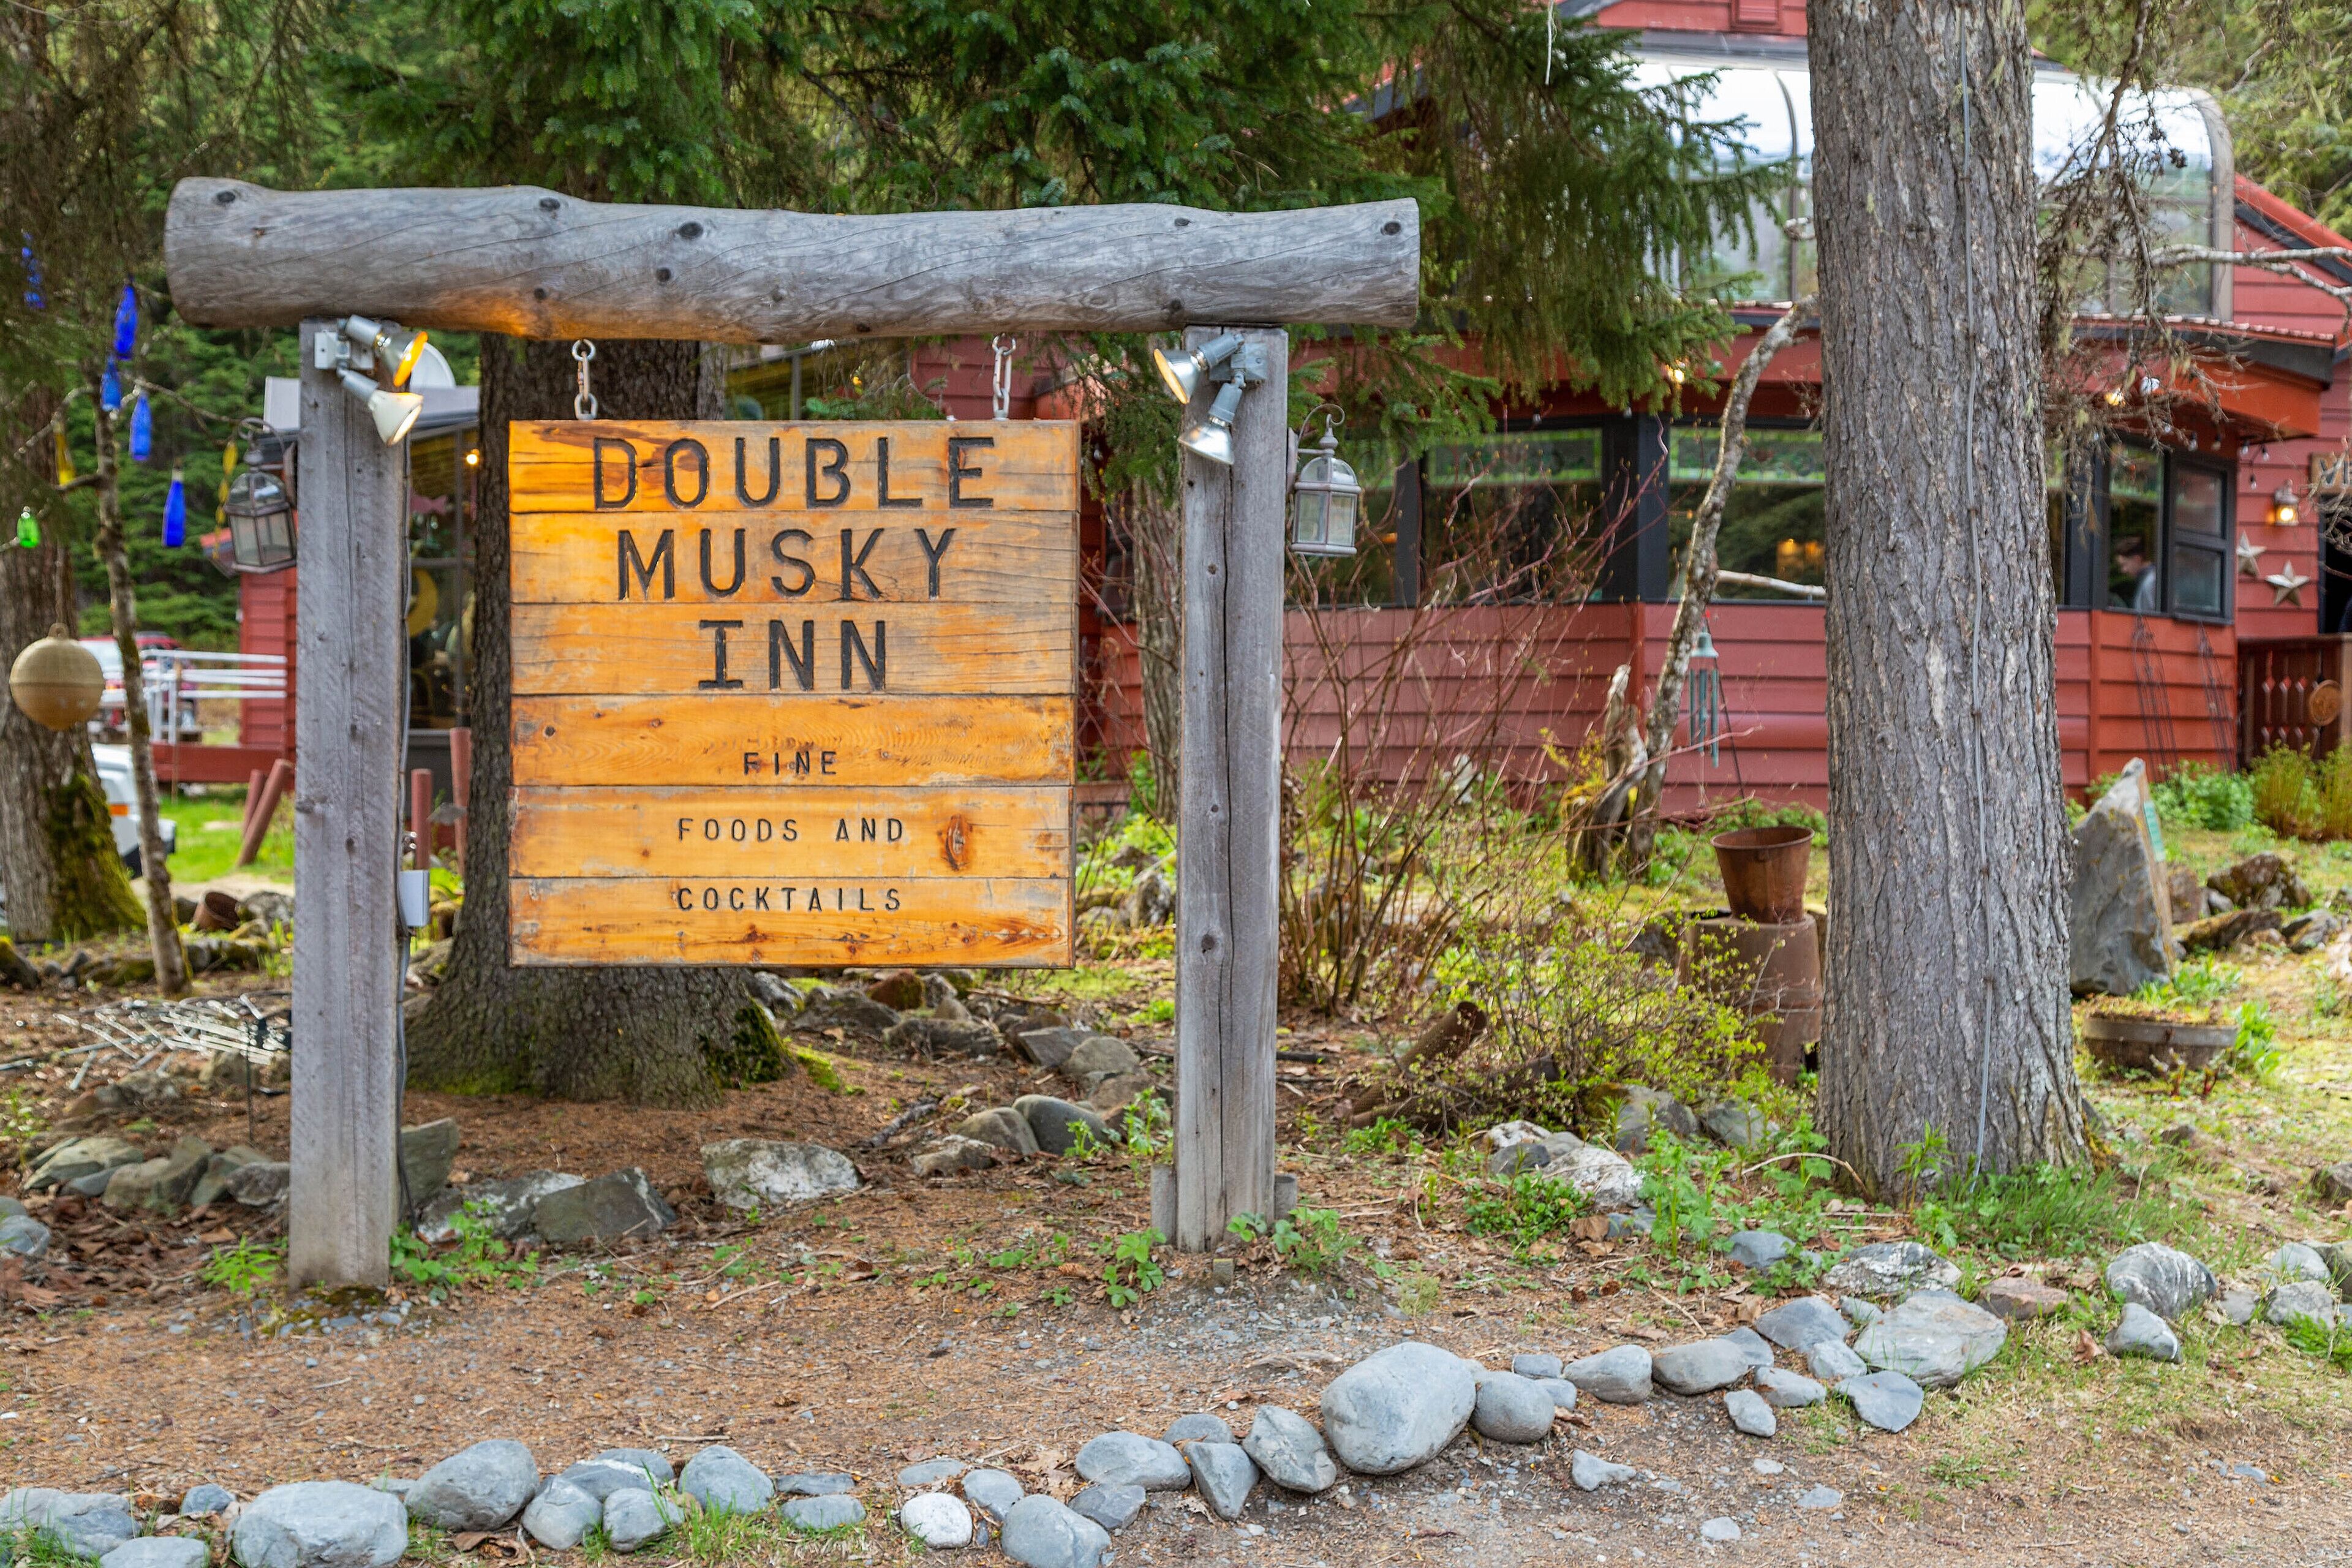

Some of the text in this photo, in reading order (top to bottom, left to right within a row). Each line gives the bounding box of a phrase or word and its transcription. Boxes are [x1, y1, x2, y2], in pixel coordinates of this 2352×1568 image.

[592, 435, 995, 510] DOUBLE
[617, 527, 957, 603] MUSKY
[698, 619, 886, 692] INN
[743, 750, 837, 775] FINE
[678, 818, 903, 842] FOODS AND
[677, 887, 901, 911] COCKTAILS
